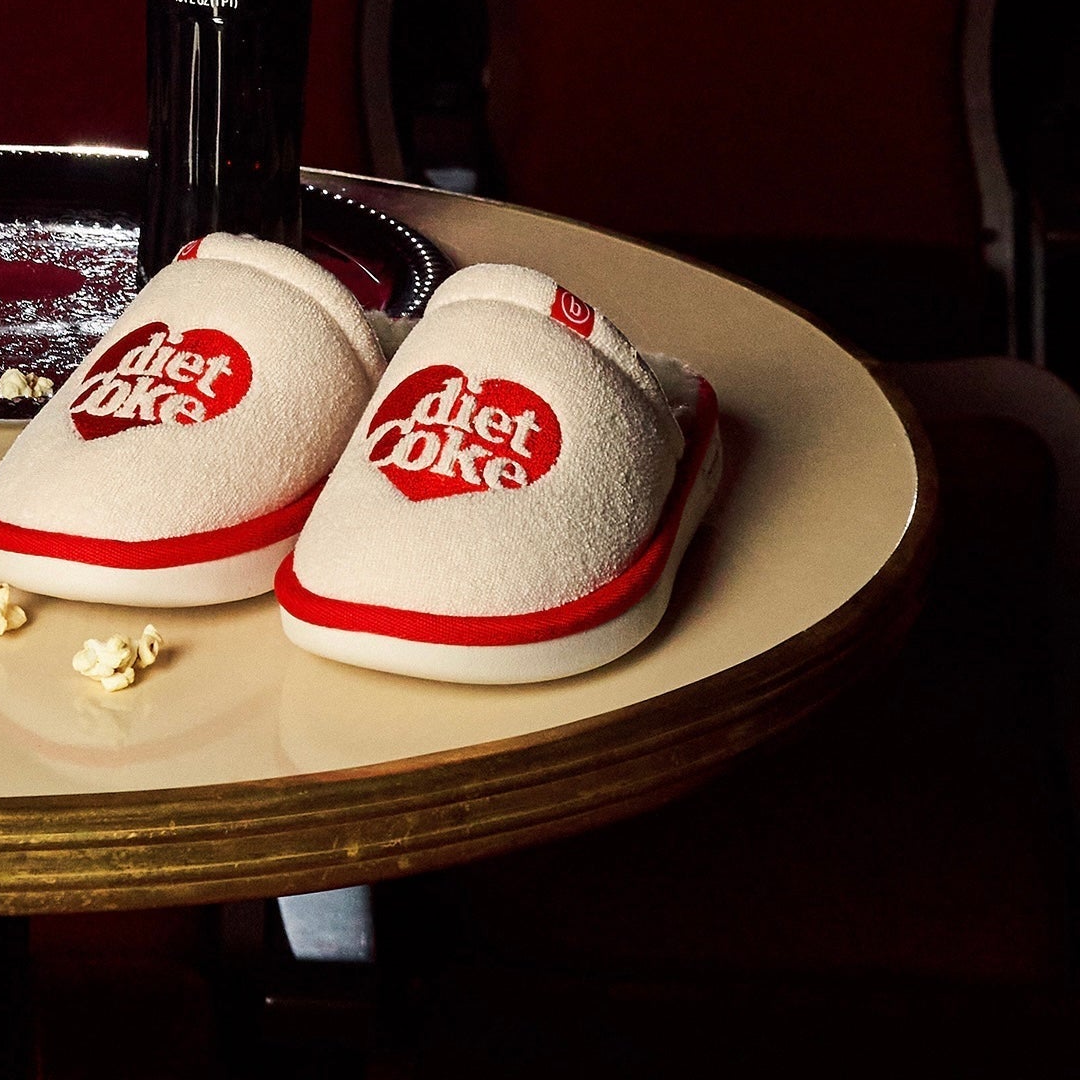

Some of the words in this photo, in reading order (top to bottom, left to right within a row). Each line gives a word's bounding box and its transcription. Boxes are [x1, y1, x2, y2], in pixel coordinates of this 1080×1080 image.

[70, 369, 208, 426] Coke
[117, 329, 233, 398] diet
[411, 375, 542, 458] diet
[366, 418, 528, 490] Coke
